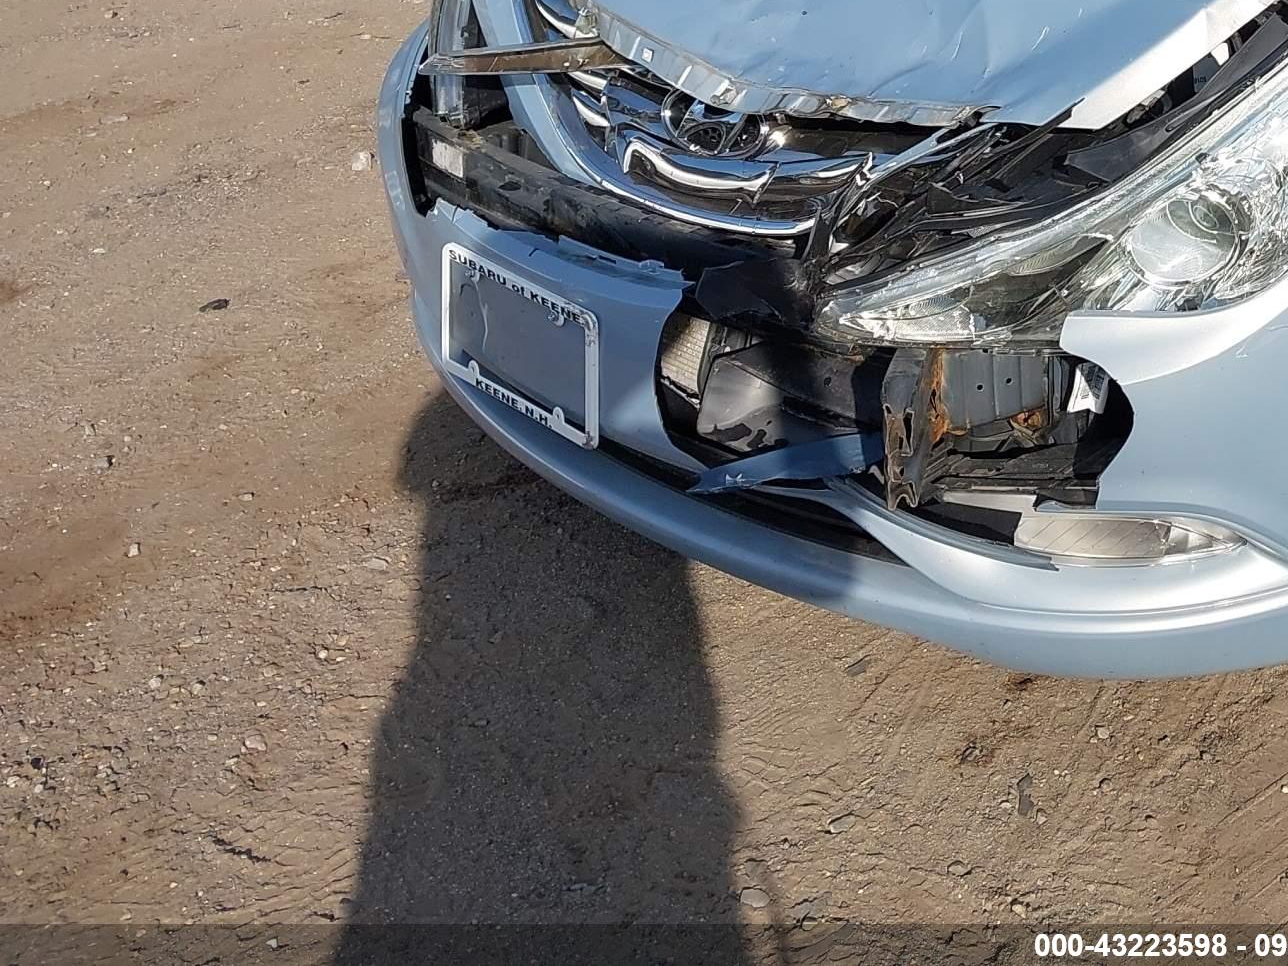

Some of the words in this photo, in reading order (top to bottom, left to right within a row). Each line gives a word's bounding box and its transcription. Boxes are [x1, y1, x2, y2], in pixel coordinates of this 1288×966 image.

[449, 249, 507, 286] SUBARU
[511, 283, 525, 296] of
[524, 405, 553, 429] N.H.
